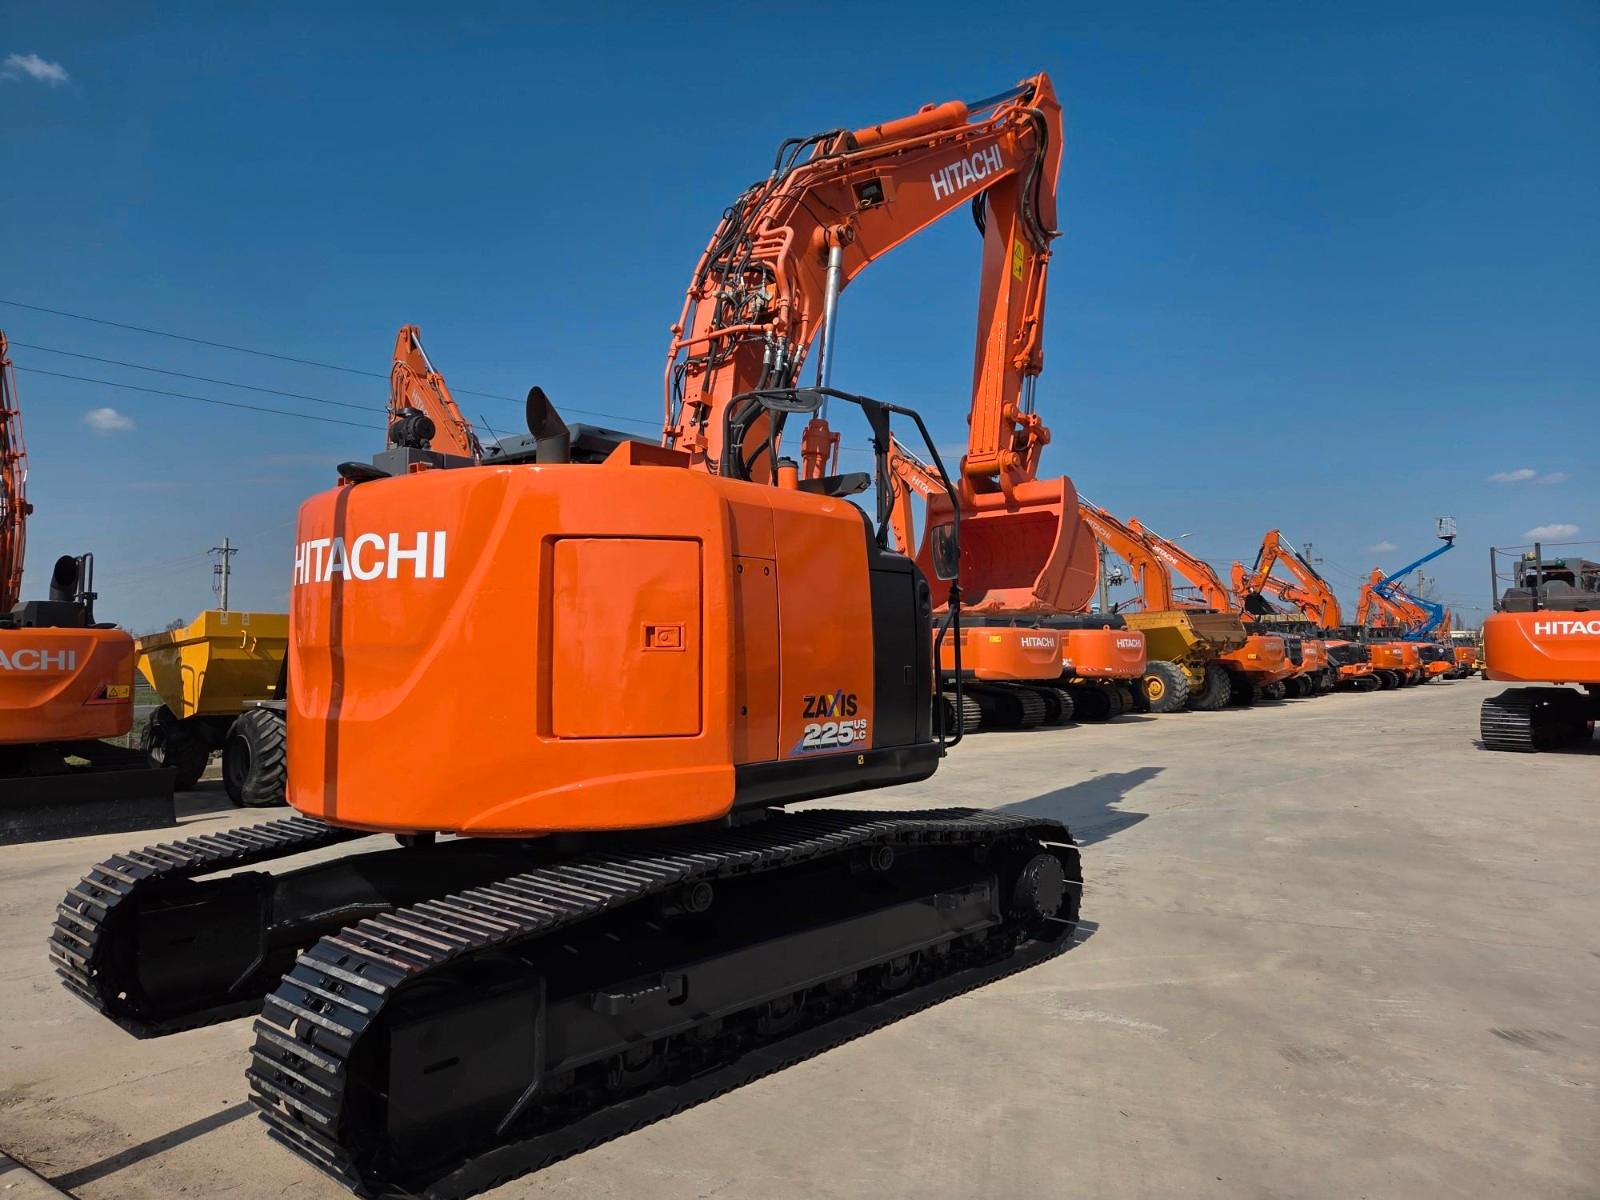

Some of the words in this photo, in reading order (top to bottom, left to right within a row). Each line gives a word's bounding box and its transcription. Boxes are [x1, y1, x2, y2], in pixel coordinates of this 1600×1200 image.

[930, 143, 1003, 201] HITACHI
[294, 531, 447, 586] HITACHI
[1021, 637, 1055, 648] HITACHI
[1116, 638, 1142, 649] HITACHI
[802, 688, 858, 718] ZAXIS
[802, 721, 854, 748] 225
